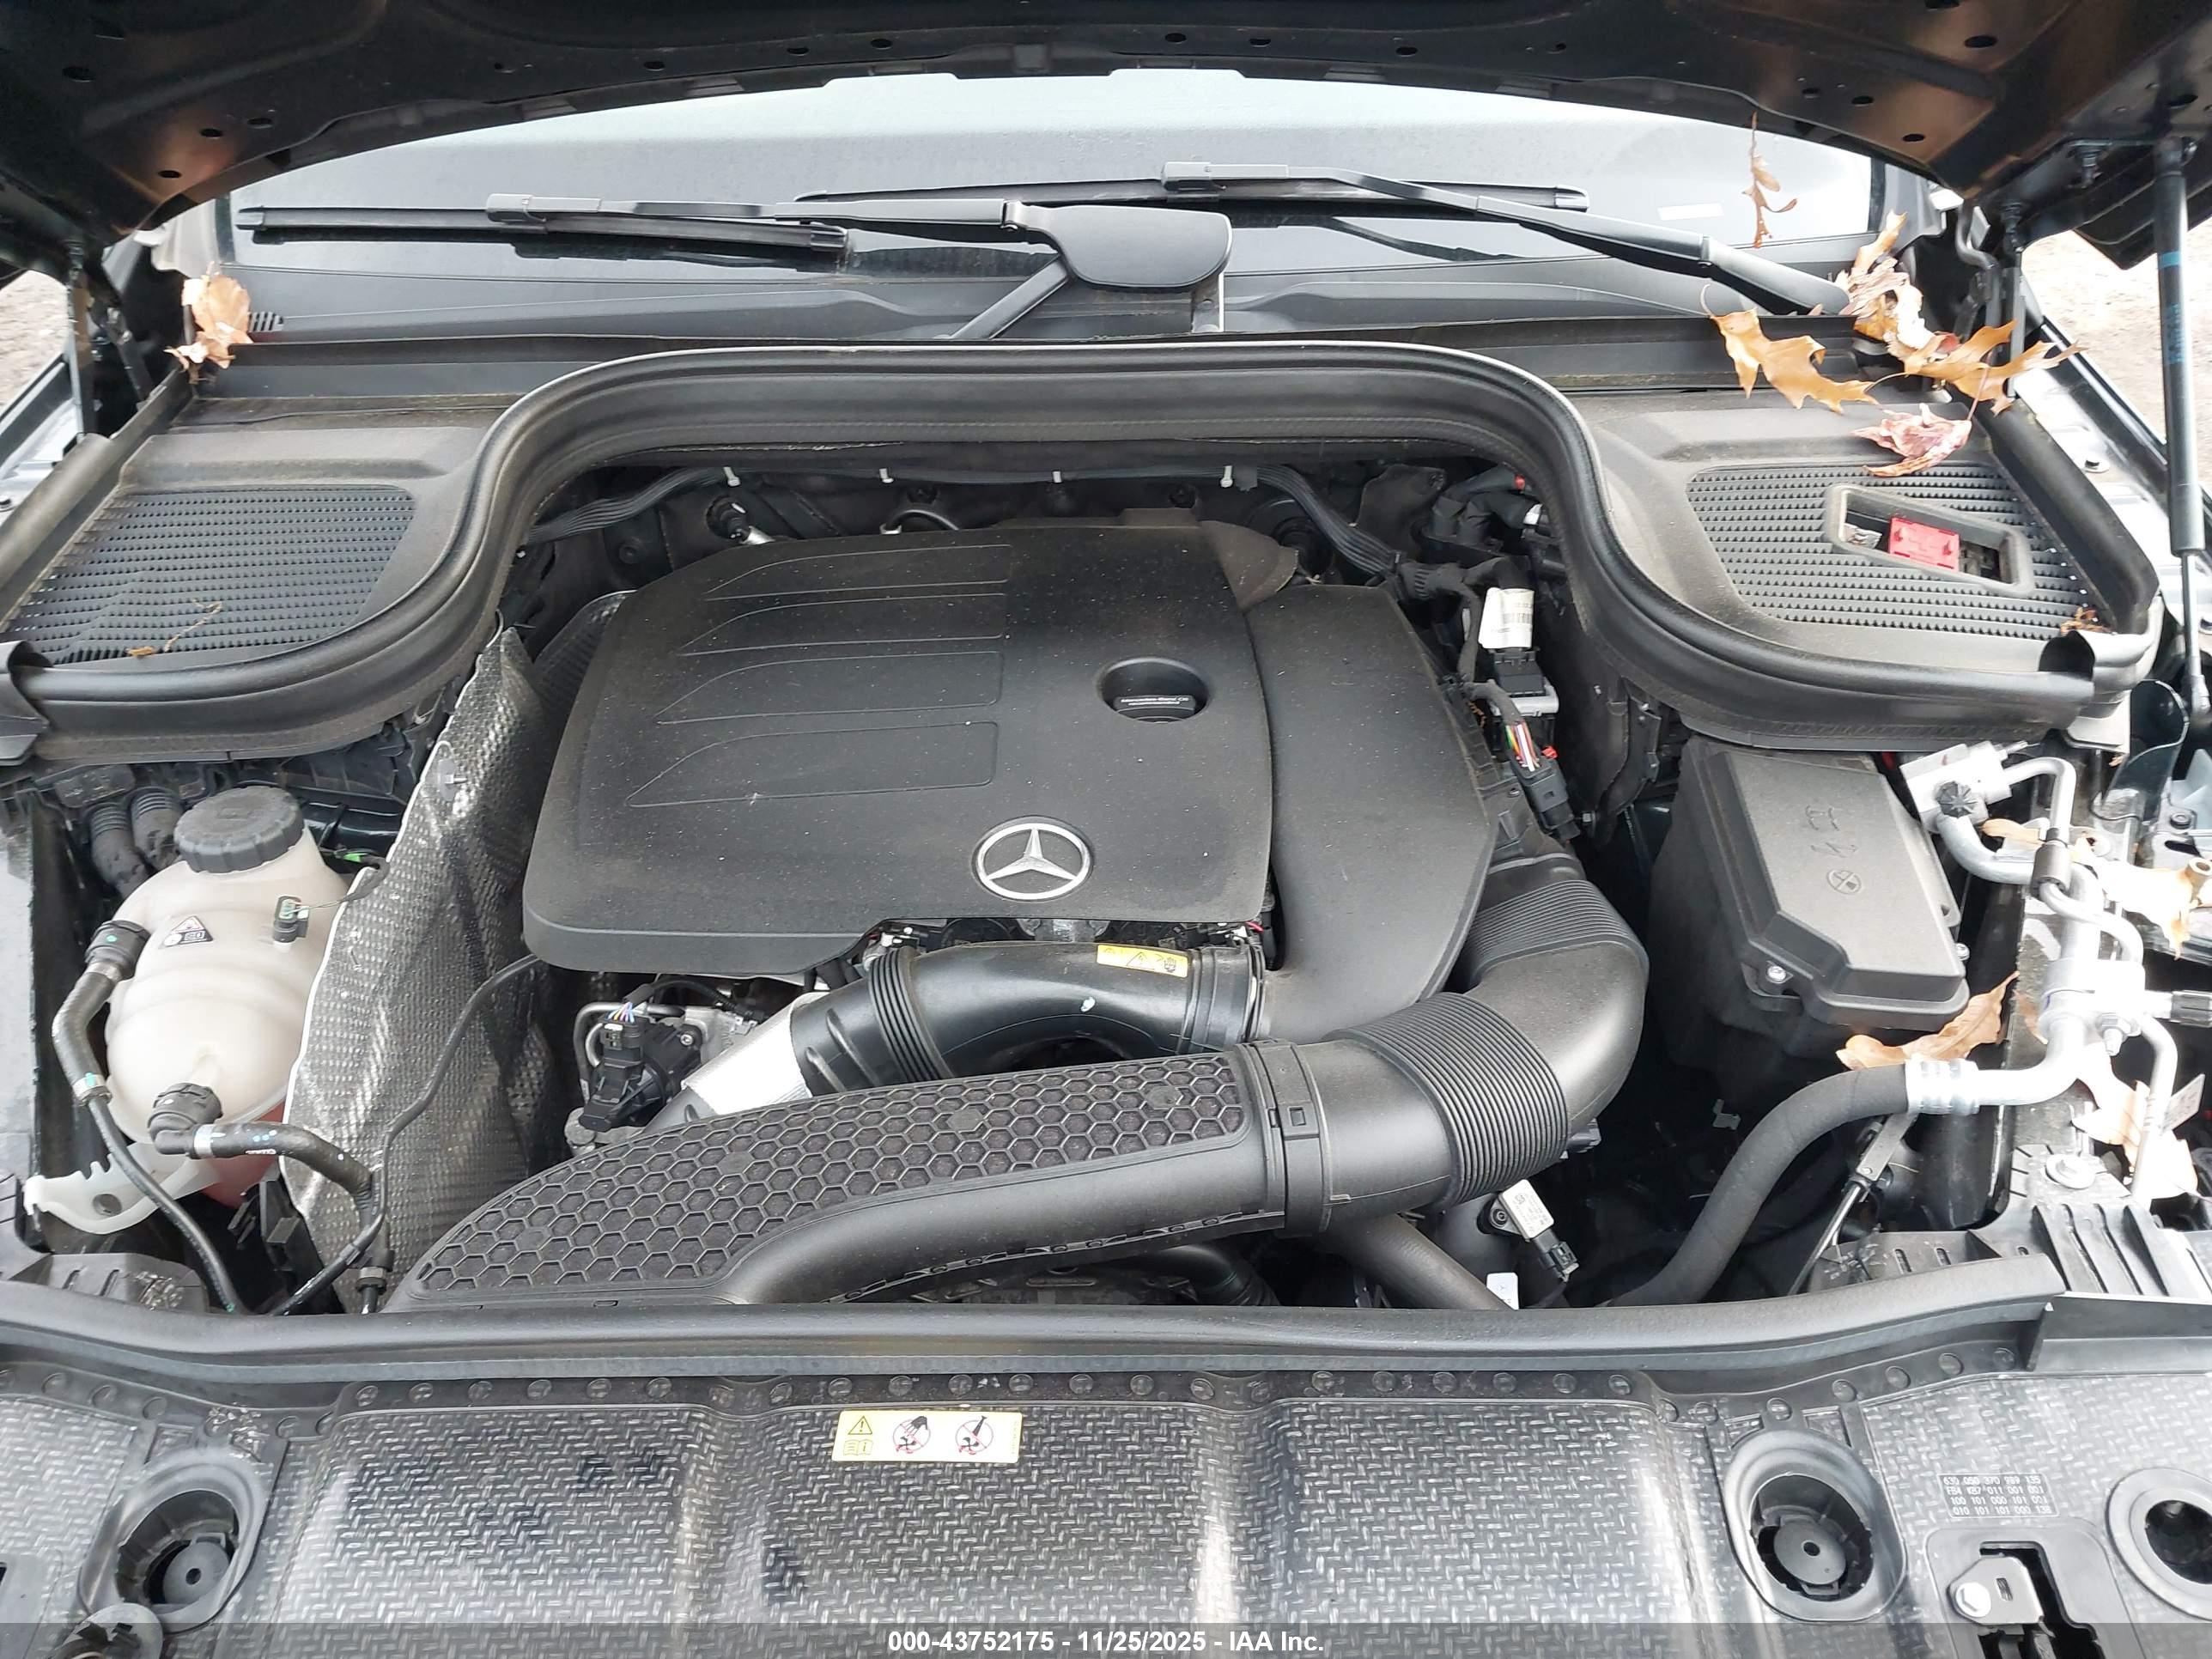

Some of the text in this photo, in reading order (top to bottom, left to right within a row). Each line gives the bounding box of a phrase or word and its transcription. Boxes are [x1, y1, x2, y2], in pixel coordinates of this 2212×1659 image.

[1987, 1486, 2002, 1495] 011
[2007, 1486, 2024, 1494] 001
[1950, 1496, 1966, 1505] 100
[1971, 1496, 1985, 1505] 101
[1990, 1496, 2007, 1505] 000
[2012, 1496, 2027, 1504] 101
[1953, 1506, 1970, 1516] 010
[1974, 1506, 1990, 1515] 101
[1995, 1506, 2010, 1515] 101
[2014, 1506, 2031, 1515] 000
